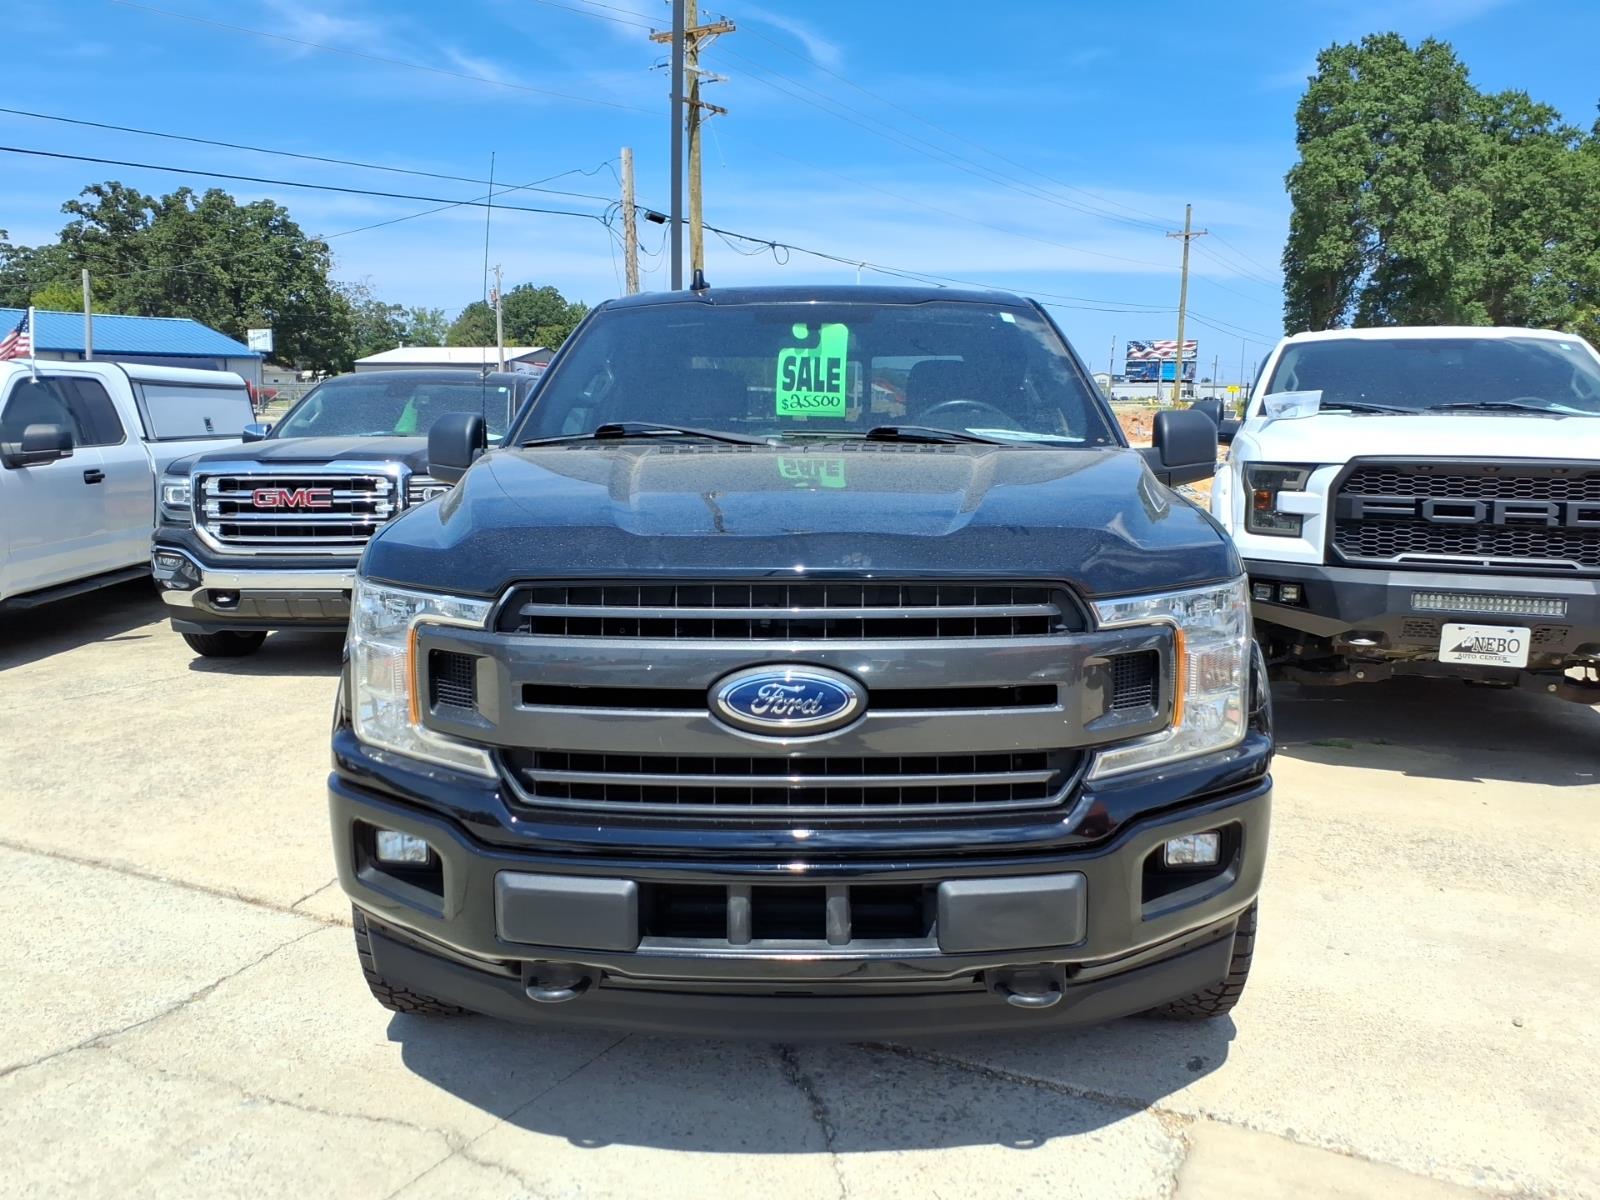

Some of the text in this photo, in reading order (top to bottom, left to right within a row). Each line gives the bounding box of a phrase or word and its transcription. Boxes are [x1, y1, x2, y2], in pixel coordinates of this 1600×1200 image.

[782, 355, 841, 393] SALE
[781, 394, 841, 410] $25500
[253, 488, 333, 507] GMC
[1472, 636, 1520, 653] NEBO
[751, 683, 823, 715] Ford
